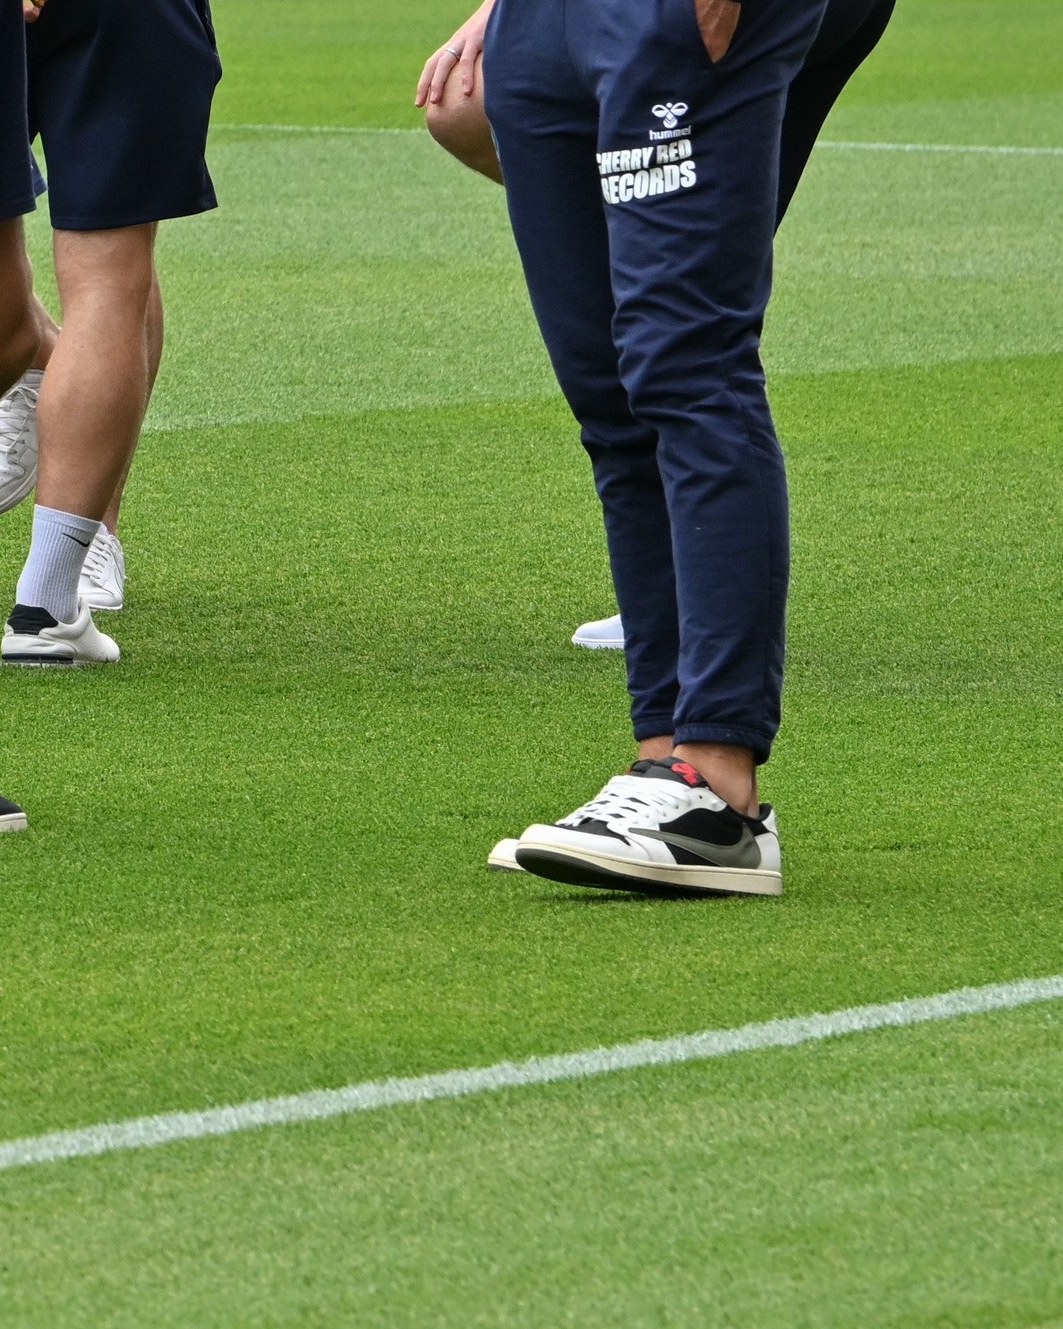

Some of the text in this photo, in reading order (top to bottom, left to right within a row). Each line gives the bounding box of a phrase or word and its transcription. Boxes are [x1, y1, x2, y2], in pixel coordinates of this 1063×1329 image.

[649, 125, 692, 140] hummel
[656, 139, 692, 164] RED
[601, 160, 697, 204] RECORDS
